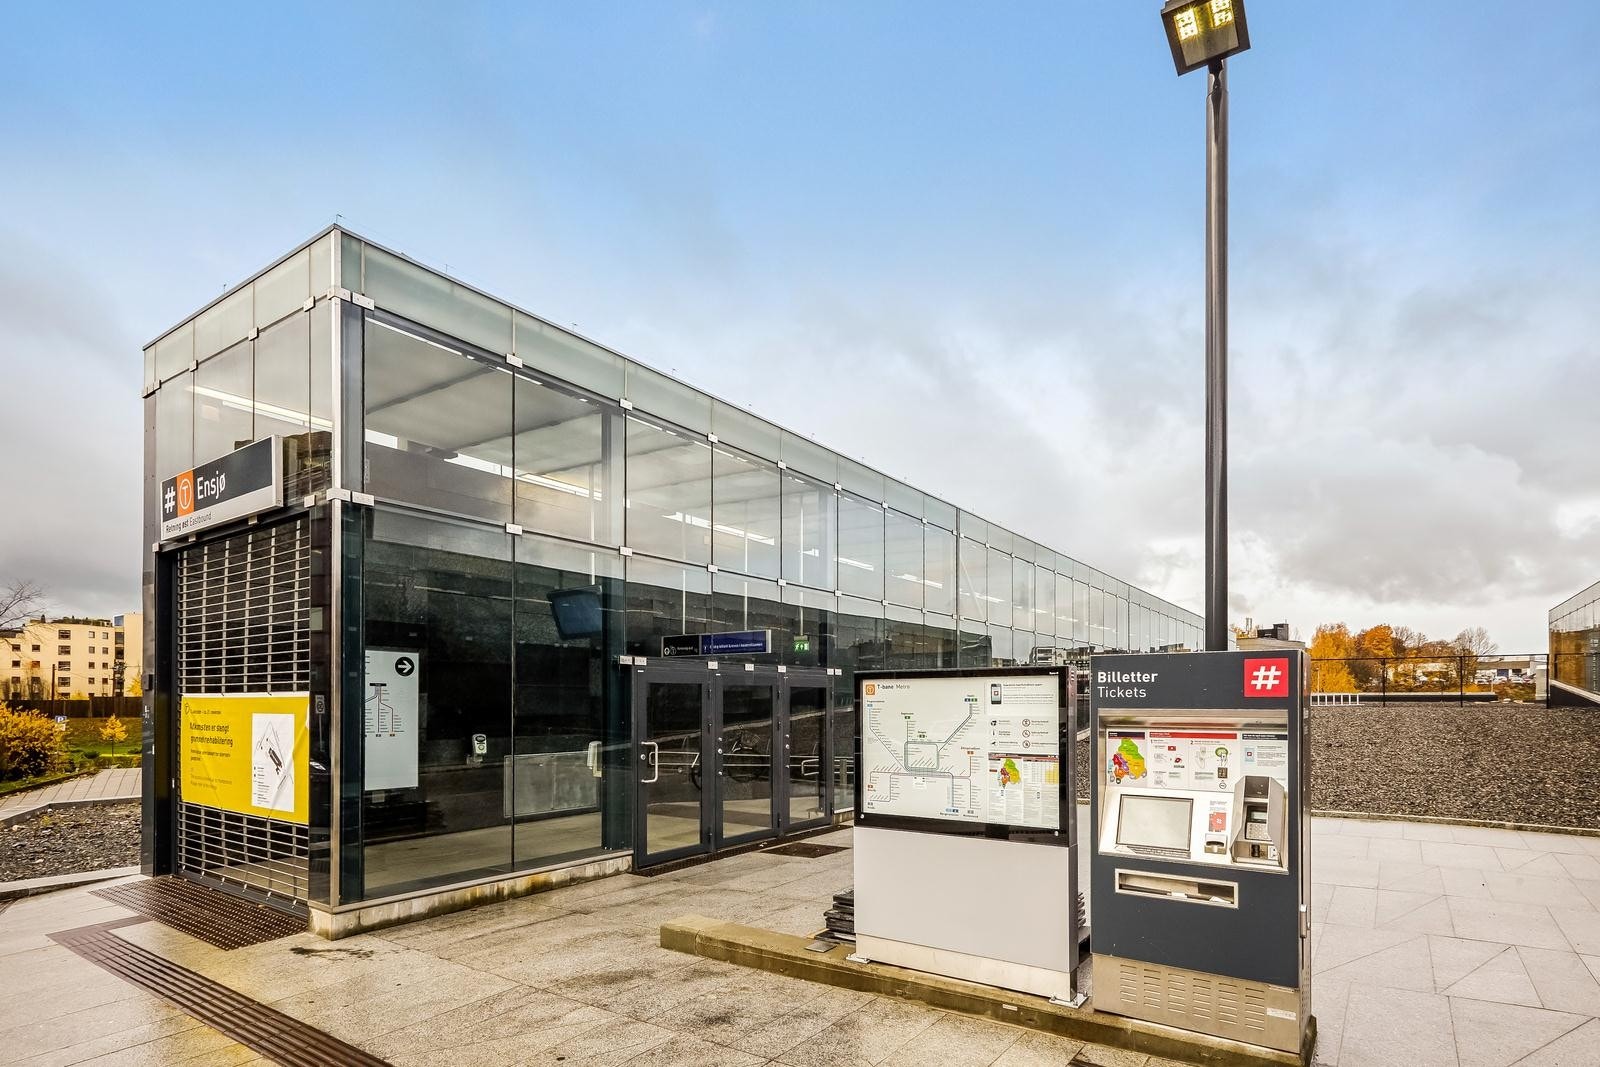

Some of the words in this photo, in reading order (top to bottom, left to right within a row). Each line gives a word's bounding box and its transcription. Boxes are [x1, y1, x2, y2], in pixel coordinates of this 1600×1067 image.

[197, 470, 226, 500] Ensjø
[1097, 671, 1158, 683] Billetter
[1097, 686, 1147, 698] Tickets
